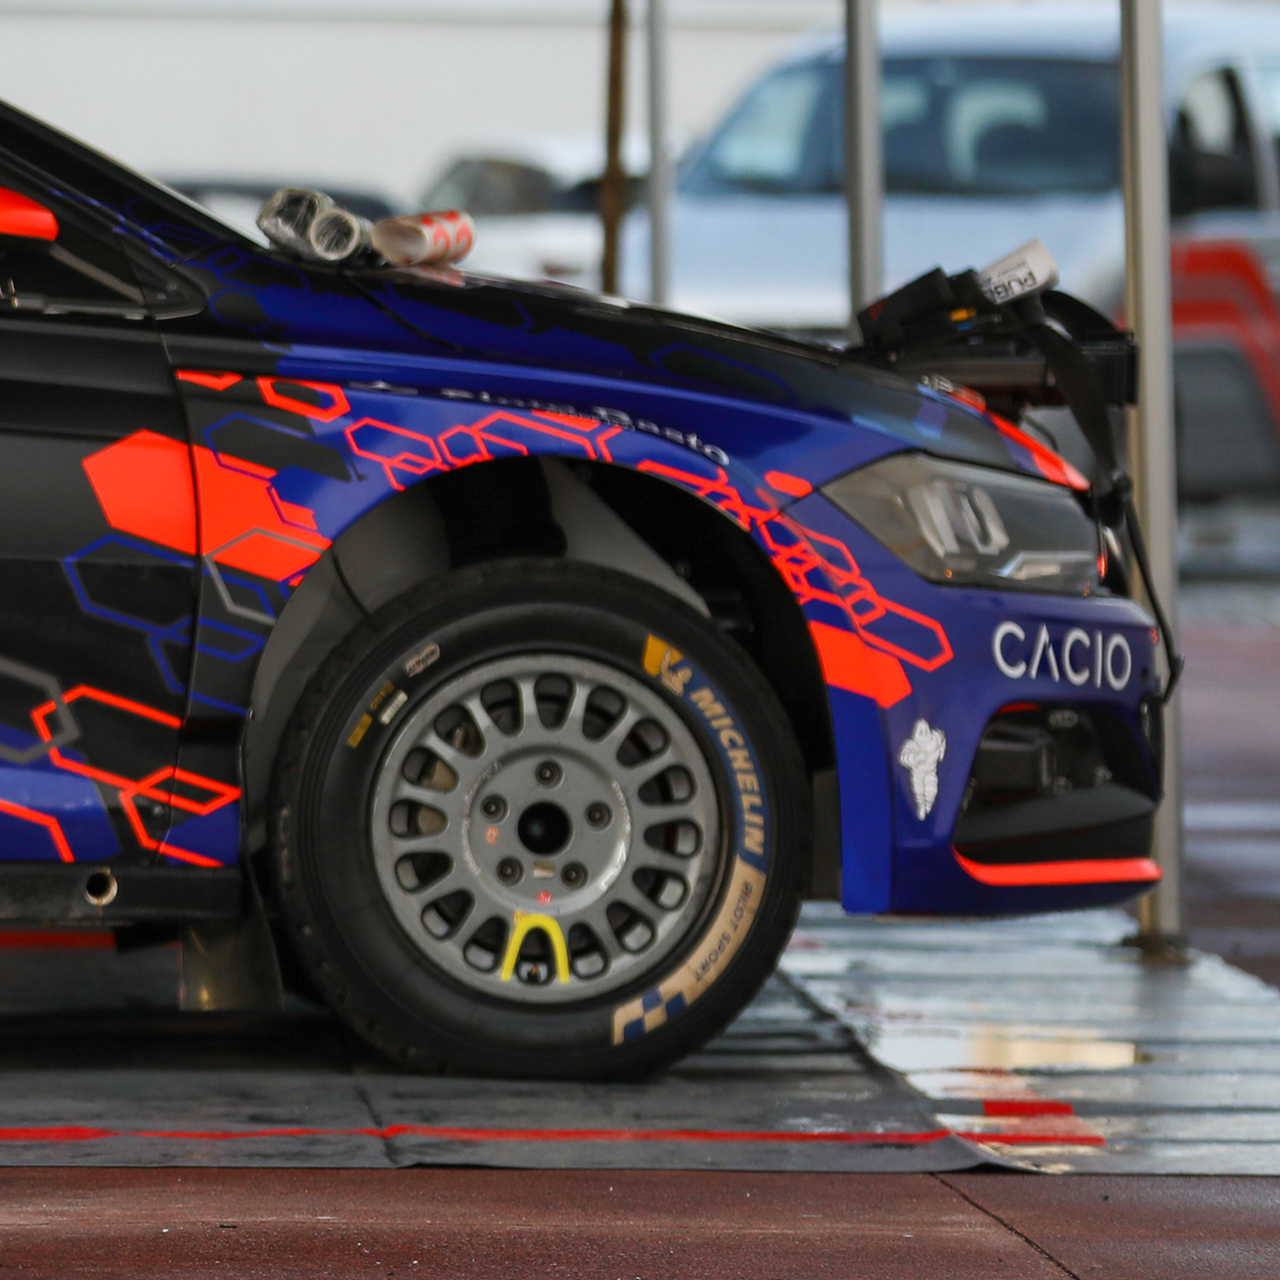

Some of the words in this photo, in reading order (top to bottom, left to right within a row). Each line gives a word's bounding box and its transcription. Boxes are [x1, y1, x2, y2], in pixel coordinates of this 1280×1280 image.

[993, 620, 1132, 692] CACIO
[691, 688, 765, 857] MICHELIN
[729, 881, 754, 932] PILOT
[694, 931, 732, 984] SPORT
